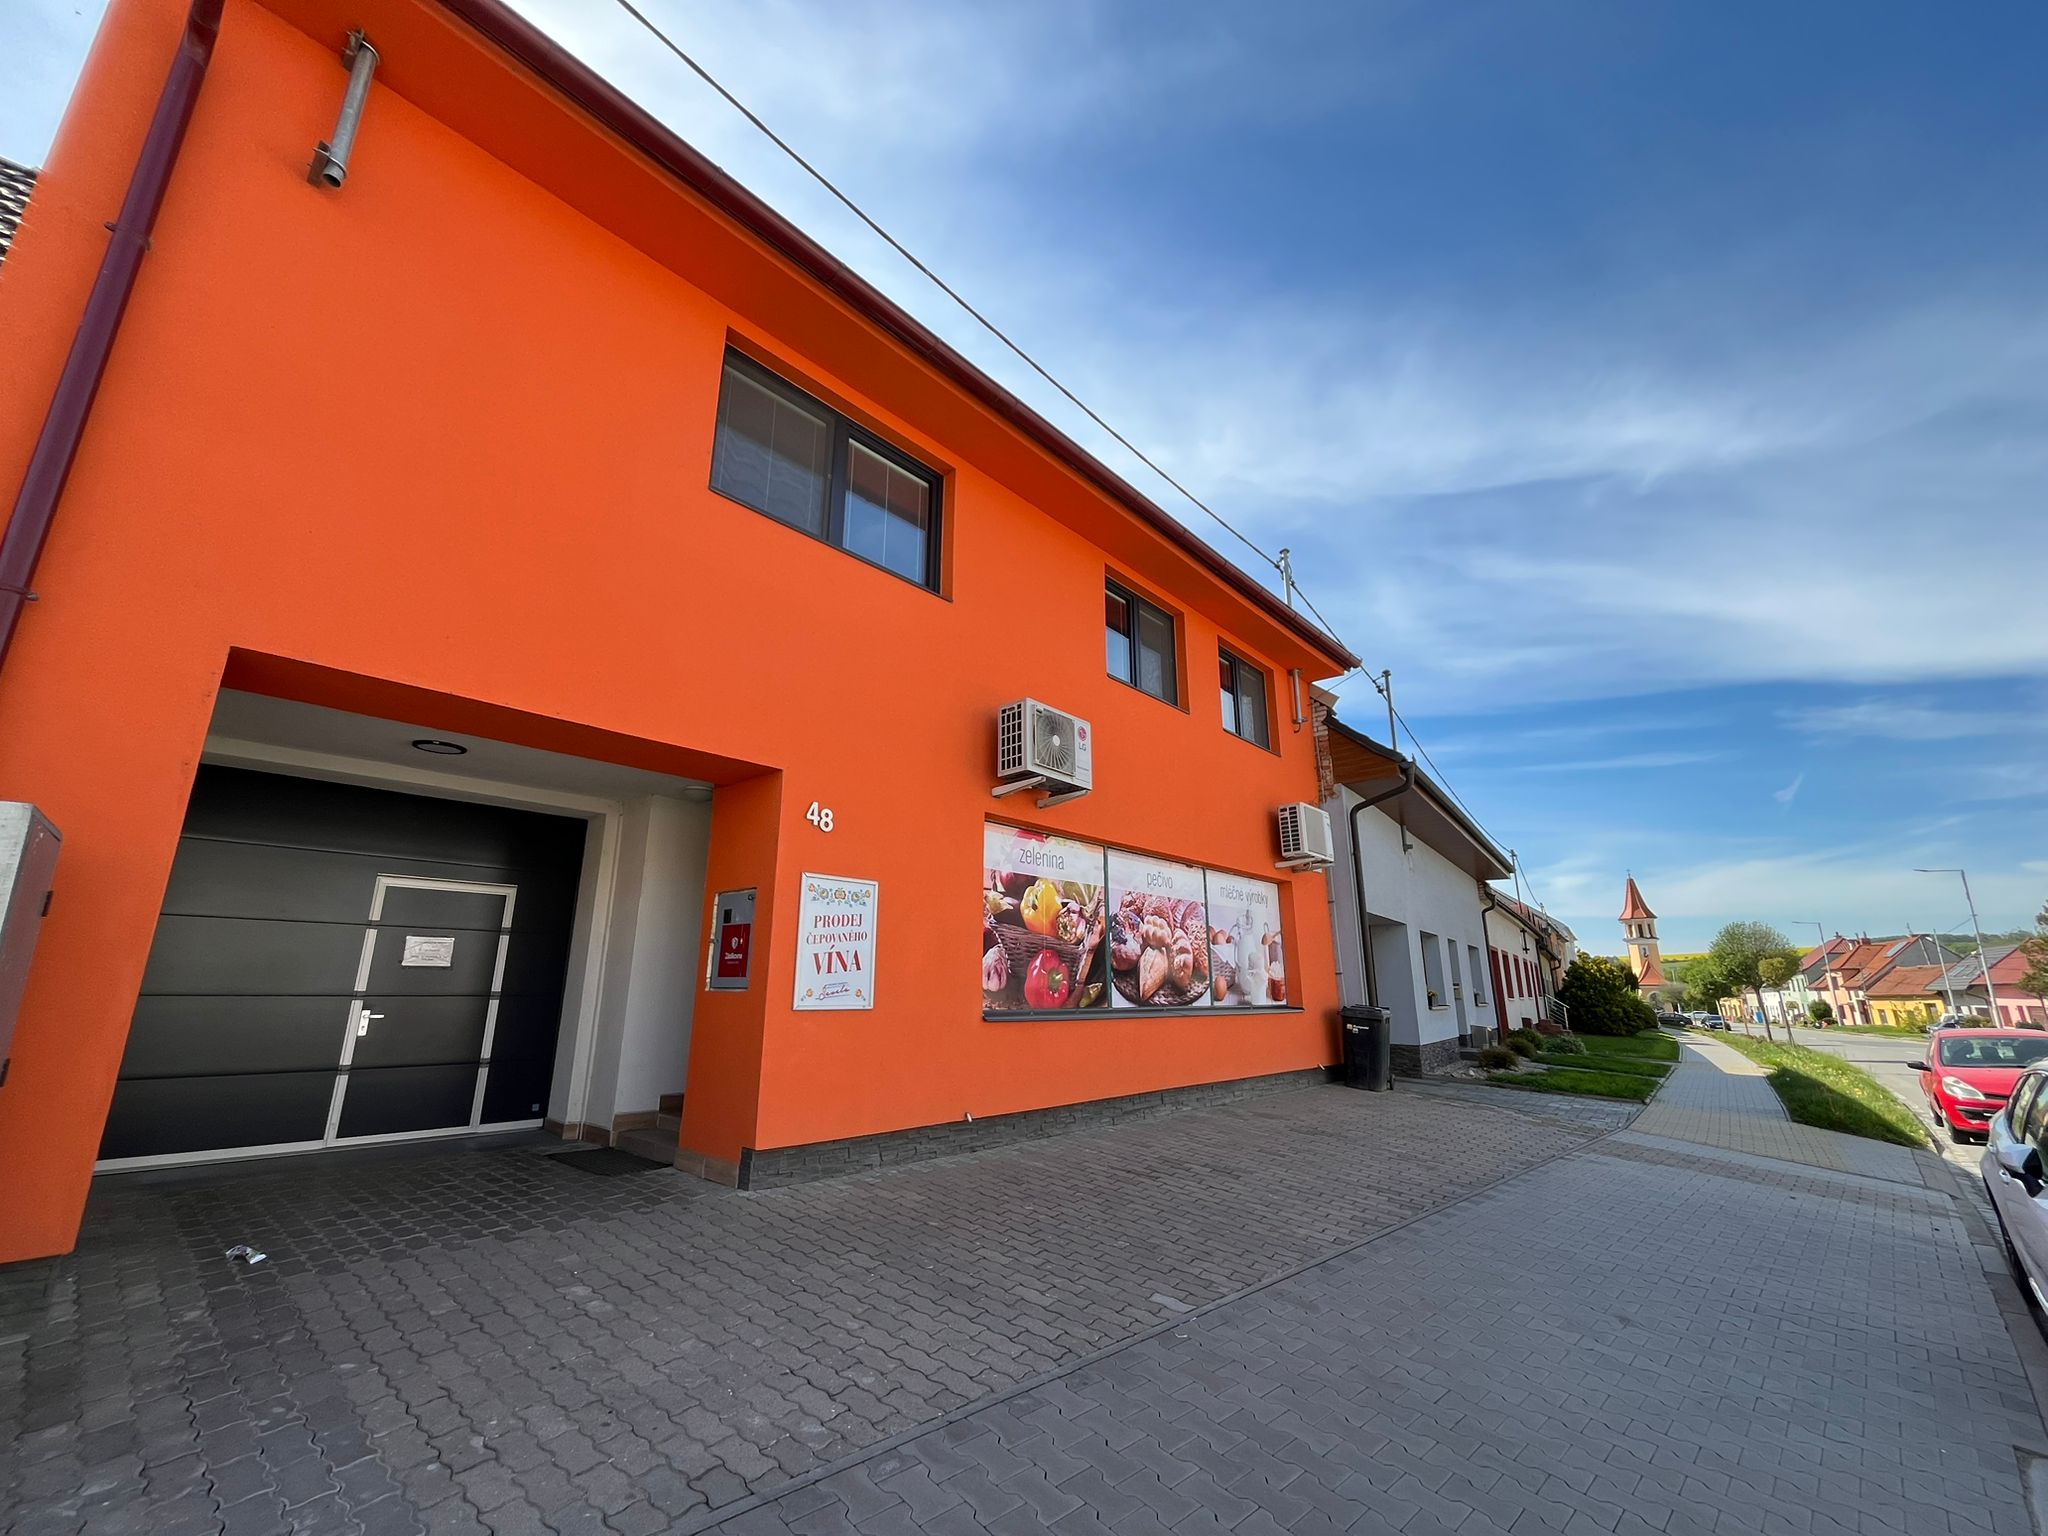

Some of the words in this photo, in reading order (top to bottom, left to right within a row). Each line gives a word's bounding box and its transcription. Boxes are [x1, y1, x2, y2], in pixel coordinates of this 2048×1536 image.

[1078, 742, 1087, 752] LG
[806, 801, 834, 832] 48
[1019, 845, 1065, 870] zelenina
[1146, 871, 1173, 889] pečivo
[814, 913, 863, 928] PRODEJ
[806, 930, 868, 945] ČEPOVANÉHO
[813, 945, 862, 975] VÍNA
